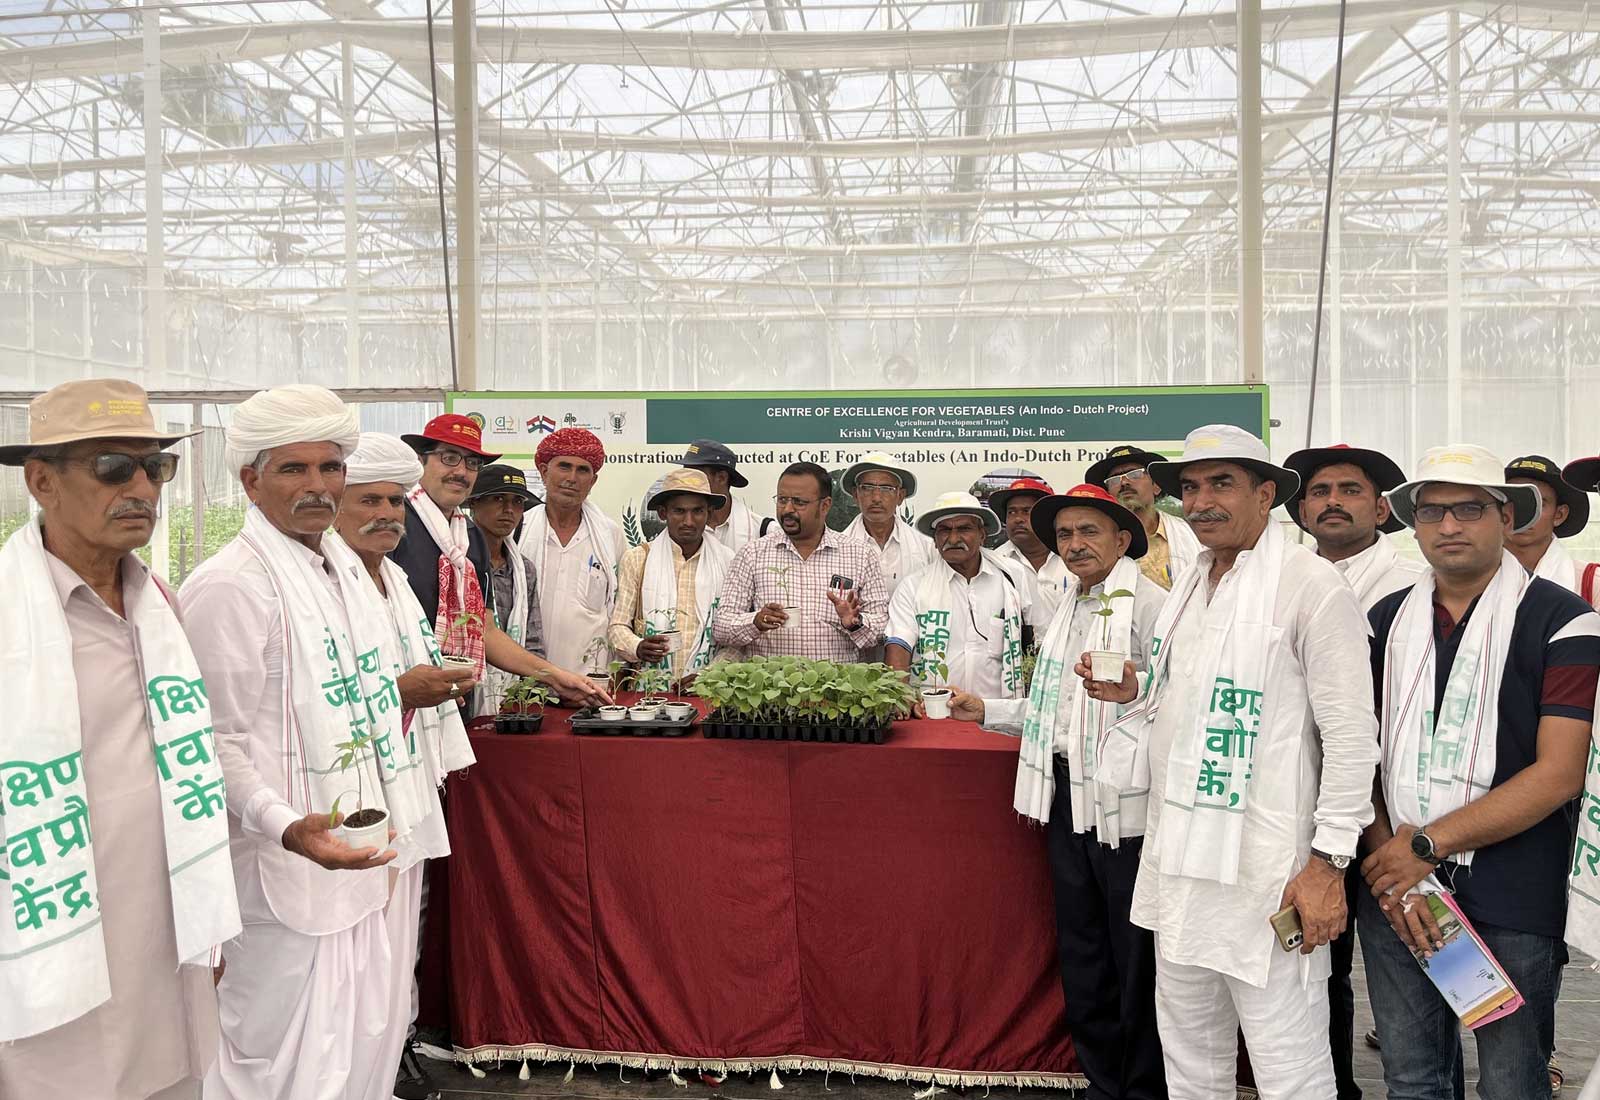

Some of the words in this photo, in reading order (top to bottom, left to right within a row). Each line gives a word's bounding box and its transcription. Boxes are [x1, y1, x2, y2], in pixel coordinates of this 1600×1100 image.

[767, 407, 812, 417] CENTRE
[815, 407, 830, 417] OF
[834, 406, 909, 417] EXCELLENCE
[912, 406, 935, 416] FOR
[938, 405, 1015, 416] VEGETABLES
[1019, 405, 1037, 416] (An
[1040, 405, 1063, 415] Indo
[1073, 404, 1104, 414] Dutch
[1107, 404, 1149, 415] Project)
[894, 419, 937, 427] Agricultural
[938, 419, 983, 427] Development
[985, 418, 1009, 426] Trust's
[840, 428, 871, 438] Krishi
[874, 428, 910, 440] Vigyan
[913, 428, 955, 439] Kendra,
[958, 427, 1009, 438] Baramati,
[1012, 427, 1036, 437] Dist.
[1039, 427, 1065, 437] Pune
[604, 451, 684, 464] onstration
[736, 451, 774, 464] ucted
[779, 452, 793, 464] at
[798, 450, 830, 464] CoE
[836, 450, 862, 464] For
[950, 449, 978, 465] (An
[984, 448, 1071, 463] Indo-Dutch
[12, 870, 94, 930] केंद्र
